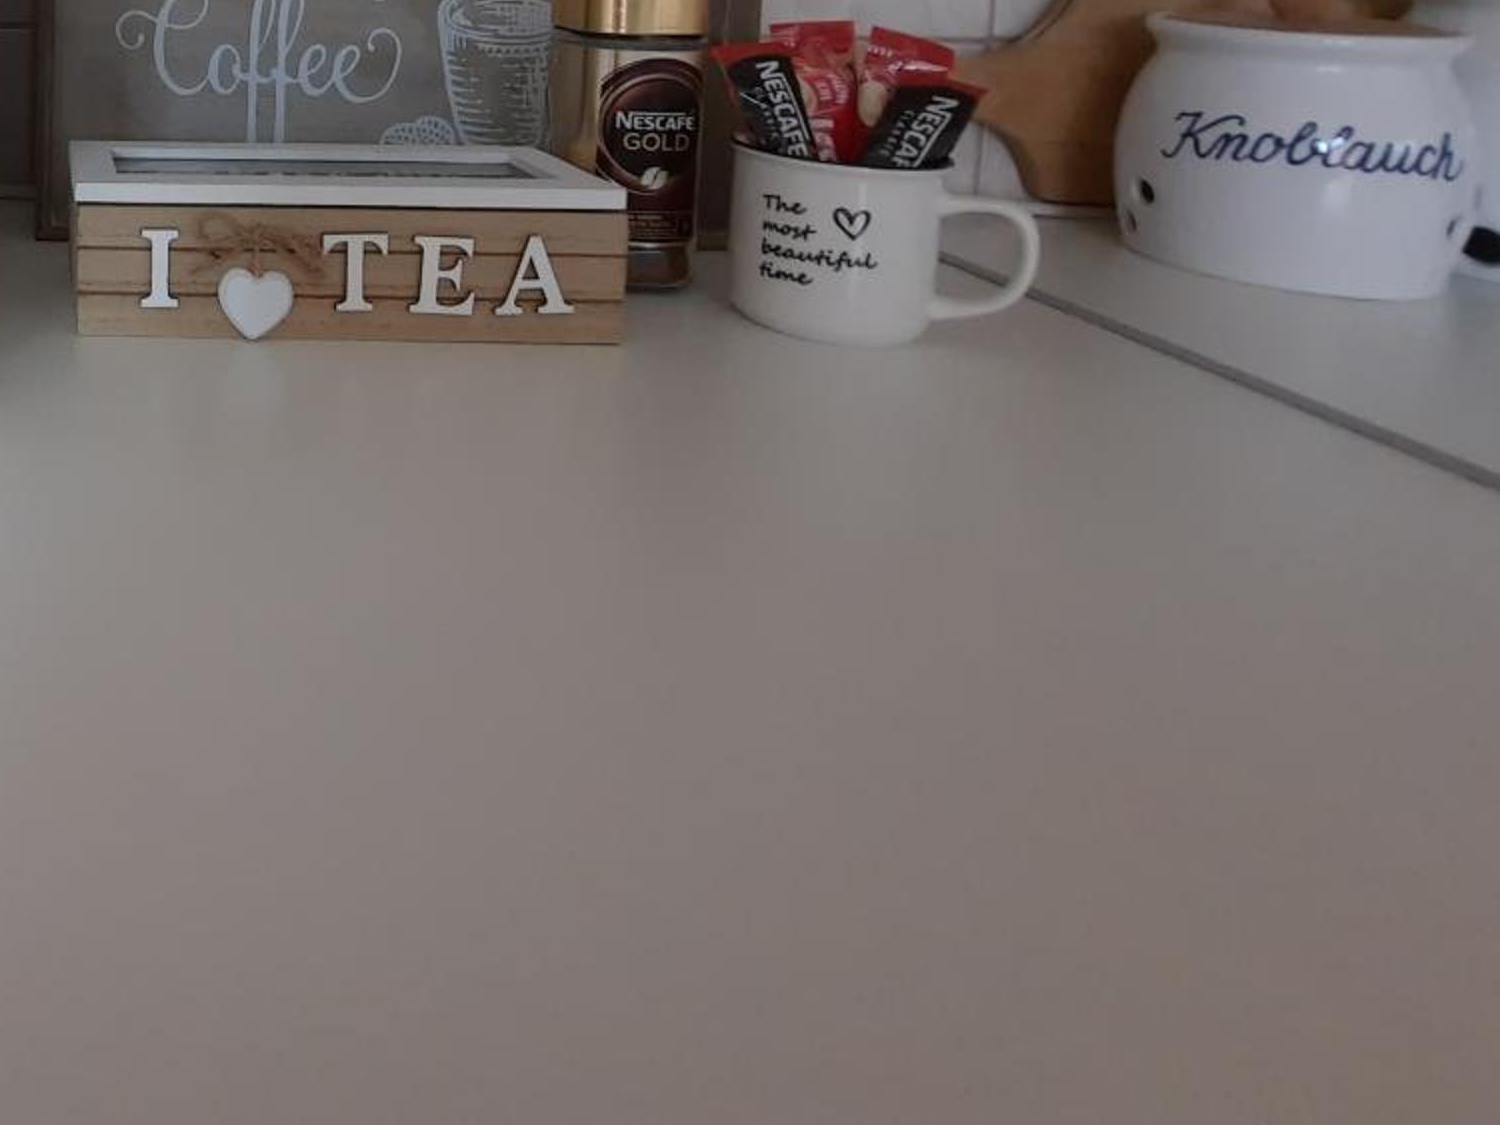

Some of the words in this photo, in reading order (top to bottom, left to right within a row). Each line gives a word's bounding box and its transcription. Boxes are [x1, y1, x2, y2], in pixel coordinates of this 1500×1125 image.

[622, 131, 691, 152] GOLD
[890, 95, 960, 168] NESCAF
[1160, 111, 1464, 181] Knoblauch
[762, 194, 808, 215] The
[762, 220, 817, 241] most
[761, 237, 879, 272] beautiful
[139, 228, 180, 309] I
[321, 231, 576, 317] TEA
[759, 261, 814, 285] time
